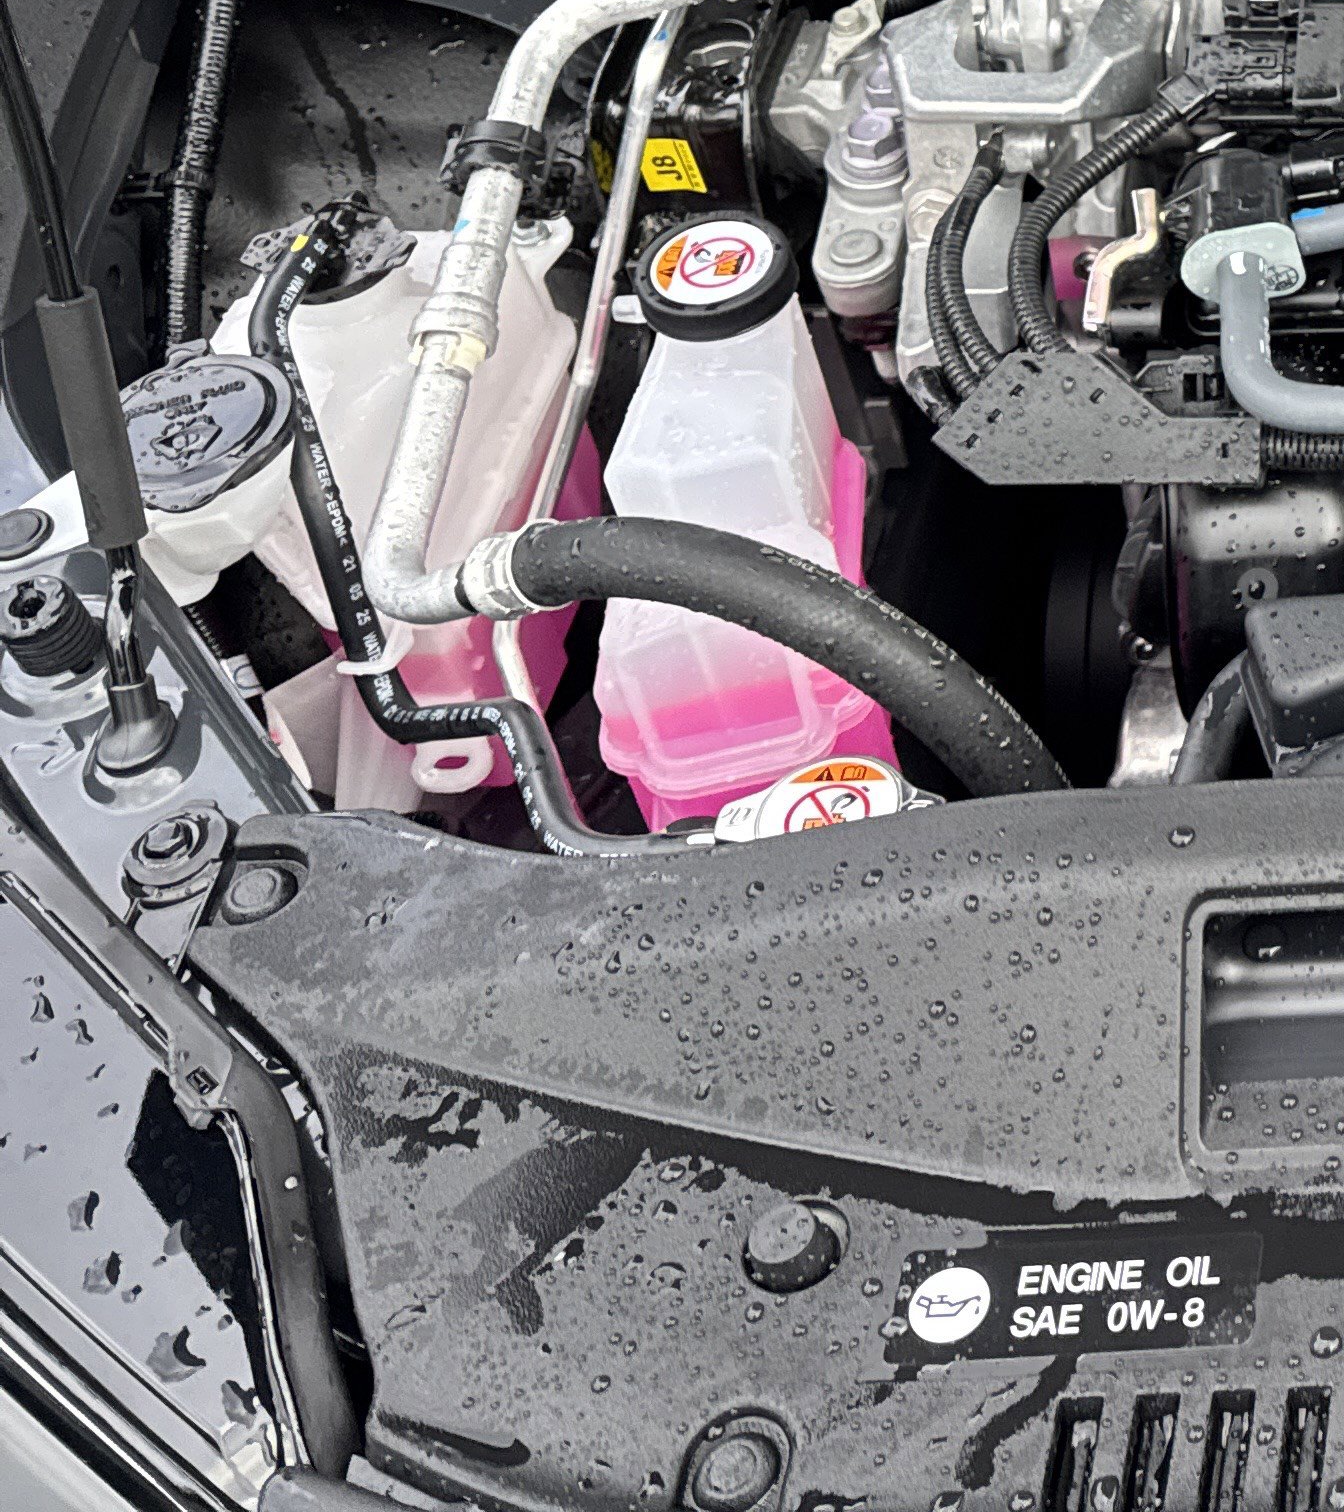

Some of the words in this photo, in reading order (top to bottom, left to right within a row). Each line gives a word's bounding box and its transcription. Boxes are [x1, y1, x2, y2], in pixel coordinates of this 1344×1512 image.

[651, 155, 682, 181] J8
[278, 275, 306, 311] WATER
[309, 442, 332, 490] WATER
[342, 555, 357, 573] 21
[356, 608, 371, 626] 25
[362, 631, 383, 663] WATE
[1017, 1259, 1145, 1296] ENGINE
[1166, 1256, 1220, 1287] OIL
[1009, 1304, 1083, 1338] SAE
[1107, 1297, 1204, 1332] 0W-8
